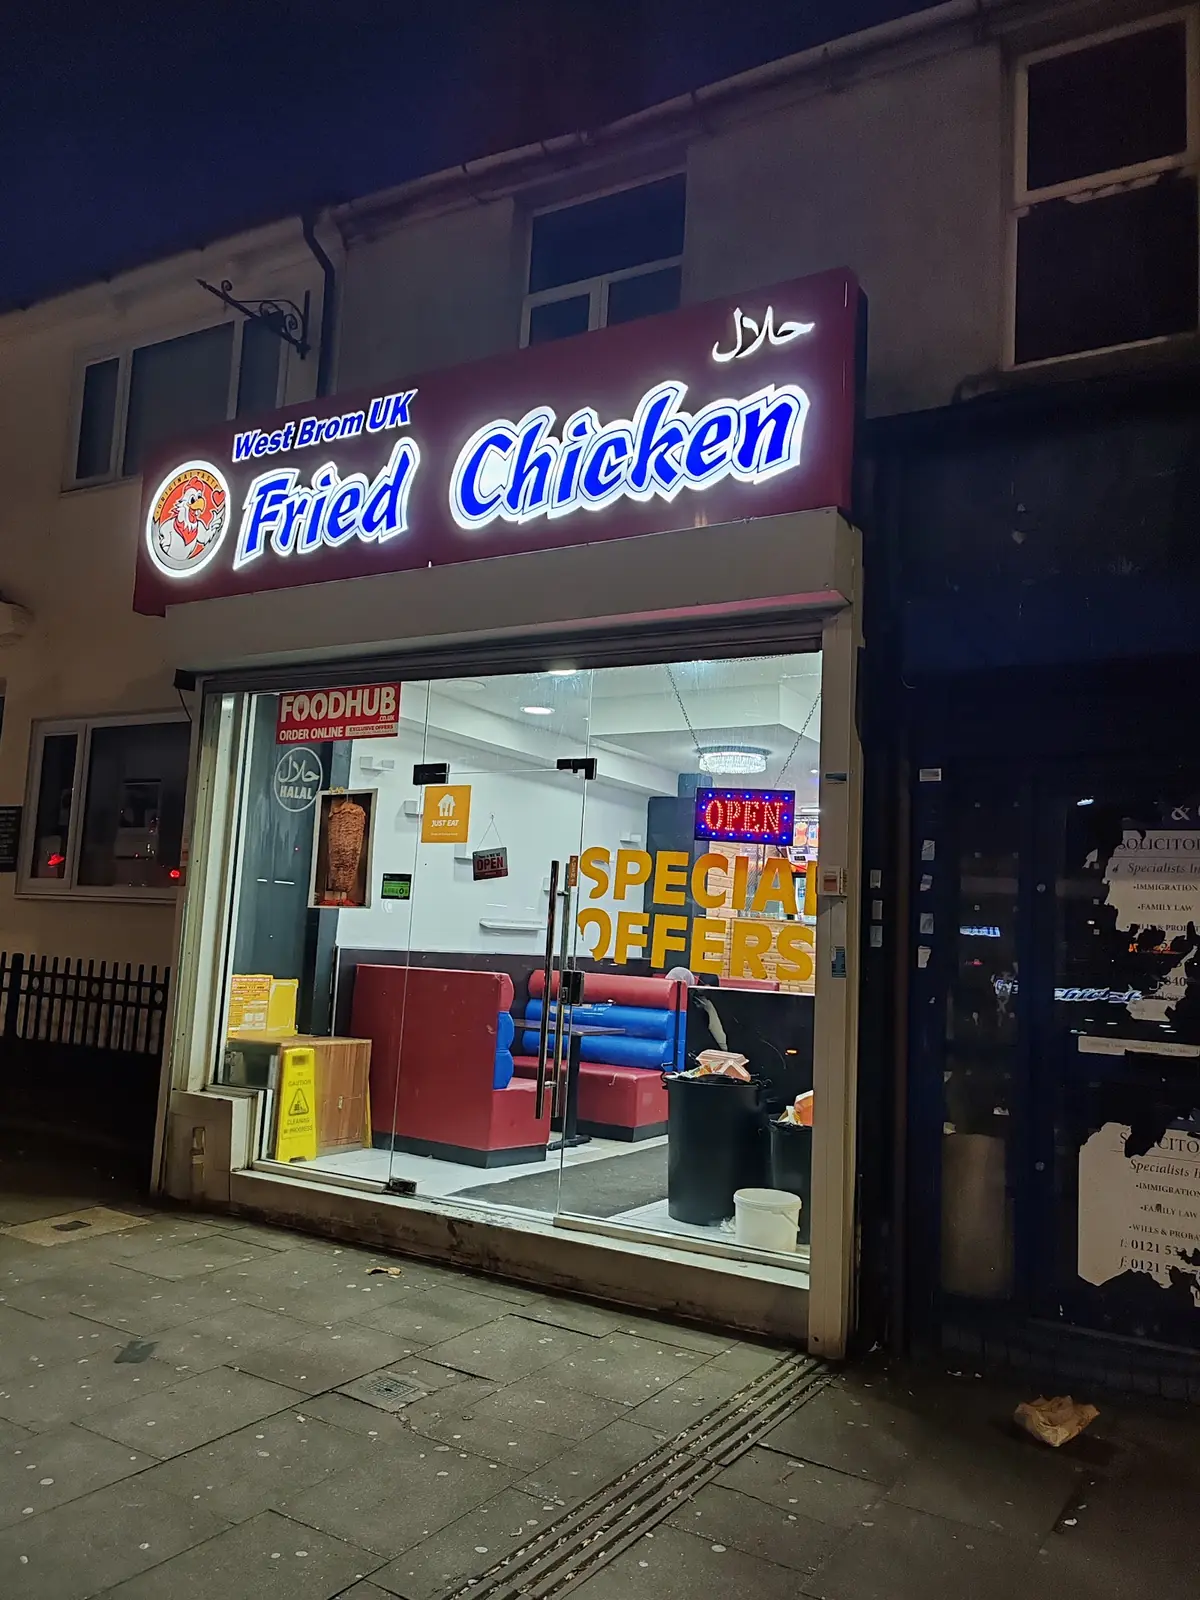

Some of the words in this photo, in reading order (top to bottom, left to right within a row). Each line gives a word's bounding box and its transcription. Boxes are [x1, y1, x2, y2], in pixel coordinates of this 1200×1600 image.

[711, 305, 816, 362] حلال
[232, 421, 296, 462] West
[294, 411, 365, 449] Brom
[366, 389, 418, 432] UK
[234, 438, 420, 569] Fried
[450, 380, 810, 529] Chicken
[281, 686, 396, 723] FOODHUB
[279, 728, 309, 742] ORDER
[310, 726, 344, 739] ONLINE
[278, 754, 320, 783] حلال
[280, 785, 313, 800] HALAL
[705, 799, 784, 833] OPEN
[1171, 804, 1191, 821] &
[431, 819, 447, 828] JUST
[447, 819, 460, 827] EAT
[1118, 838, 1200, 851] SOLICITO
[477, 856, 504, 871] OPEN
[1127, 862, 1186, 876] Specialists
[1136, 883, 1198, 891] IMMIGRATION
[1141, 903, 1172, 911] FAMILY
[1174, 904, 1194, 912] LAW
[577, 907, 816, 981] OFFERS
[288, 1079, 312, 1087] CAUTION
[1130, 1158, 1190, 1177] Specialists
[1132, 1223, 1159, 1235] WILLS
[1160, 1228, 1167, 1236] &
[1130, 1238, 1160, 1254] 0121
[1130, 1257, 1160, 1273] 0121
